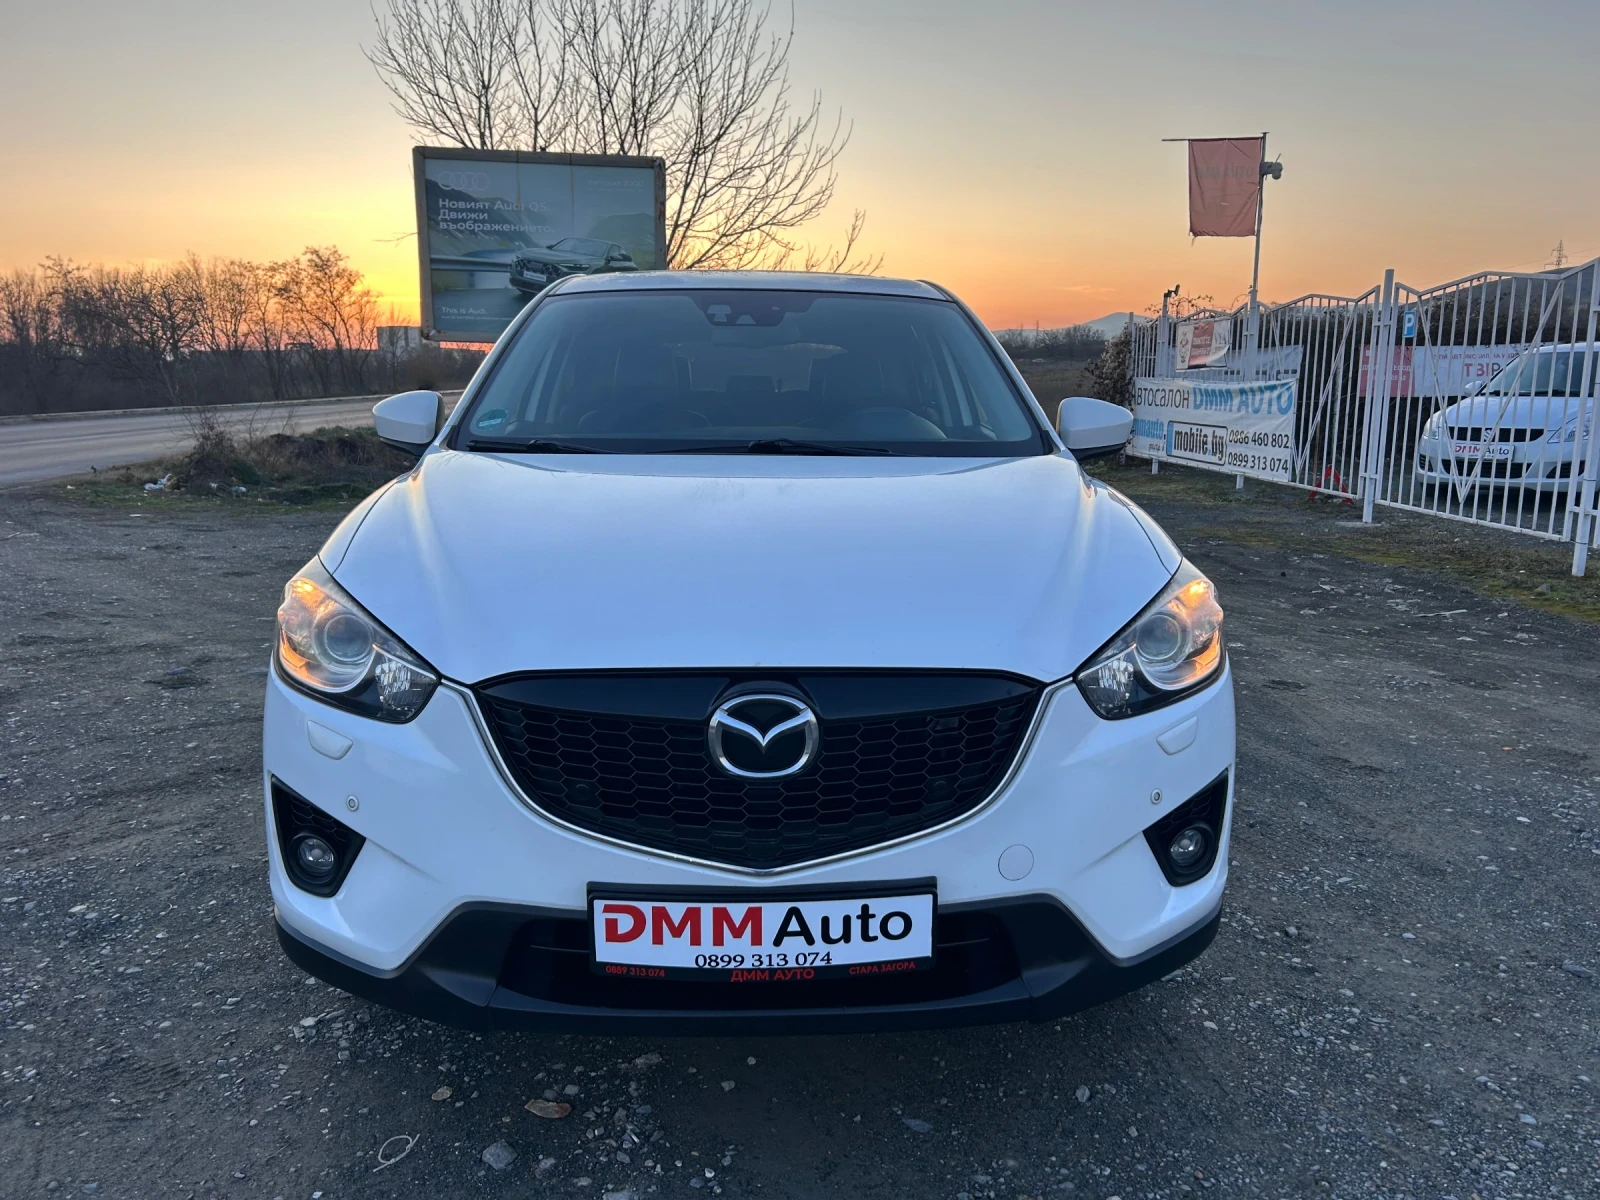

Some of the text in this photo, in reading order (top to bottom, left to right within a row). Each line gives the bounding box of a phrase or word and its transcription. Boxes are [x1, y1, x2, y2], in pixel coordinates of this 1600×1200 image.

[438, 198, 490, 210] Новият
[494, 201, 525, 211] Audi
[438, 209, 489, 221] Движи
[441, 306, 458, 314] This
[1404, 313, 1415, 334] P
[1192, 386, 1233, 413] DMM
[1237, 384, 1294, 415] AUTO
[1174, 427, 1225, 462] mobile.bg
[1229, 429, 1290, 449] 0886 460 802
[1228, 452, 1289, 474] 0899 313 074
[602, 903, 913, 947] DMM Auto
[694, 951, 833, 968] 0899 313 074
[848, 961, 916, 975] СТАРА ЗАГОРА
[605, 964, 666, 978] 0889 313 074
[730, 968, 815, 983] ДММ АУТО
